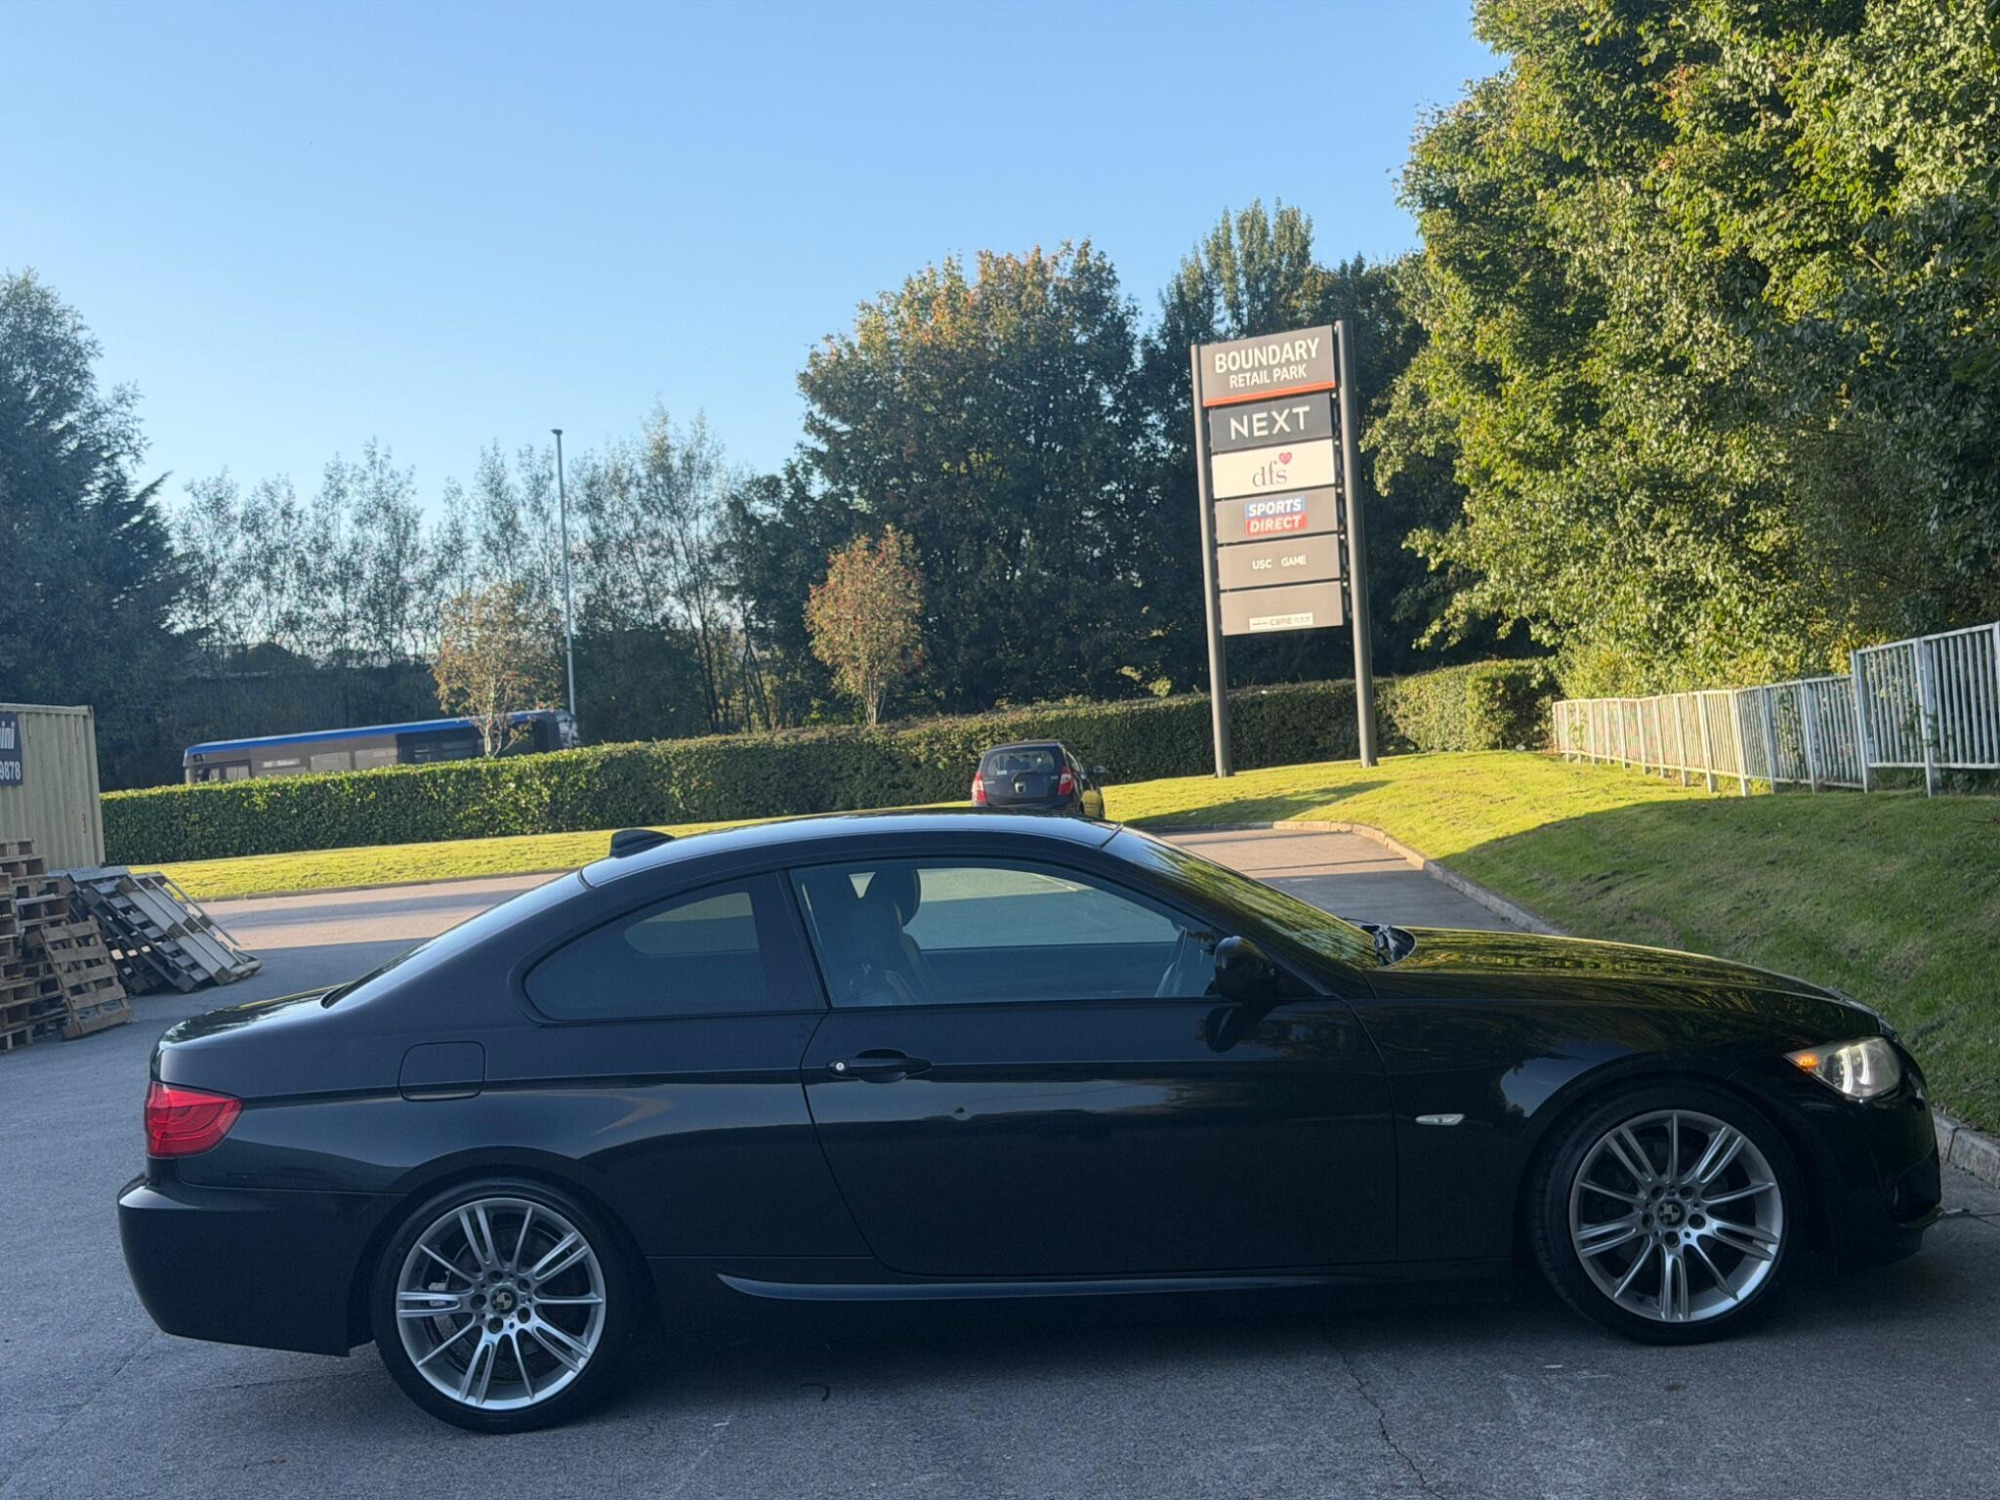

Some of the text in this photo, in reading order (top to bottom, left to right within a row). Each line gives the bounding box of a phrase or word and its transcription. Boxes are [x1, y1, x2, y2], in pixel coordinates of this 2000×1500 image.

[1214, 338, 1320, 373] BOUNDARY
[1229, 364, 1307, 389] RETAIL PARK
[1230, 406, 1310, 440] NEXT
[1252, 460, 1288, 487] dfs
[1248, 498, 1302, 517] SPORTS
[1250, 514, 1303, 533] DIRECT
[1252, 555, 1307, 570] USC GAME
